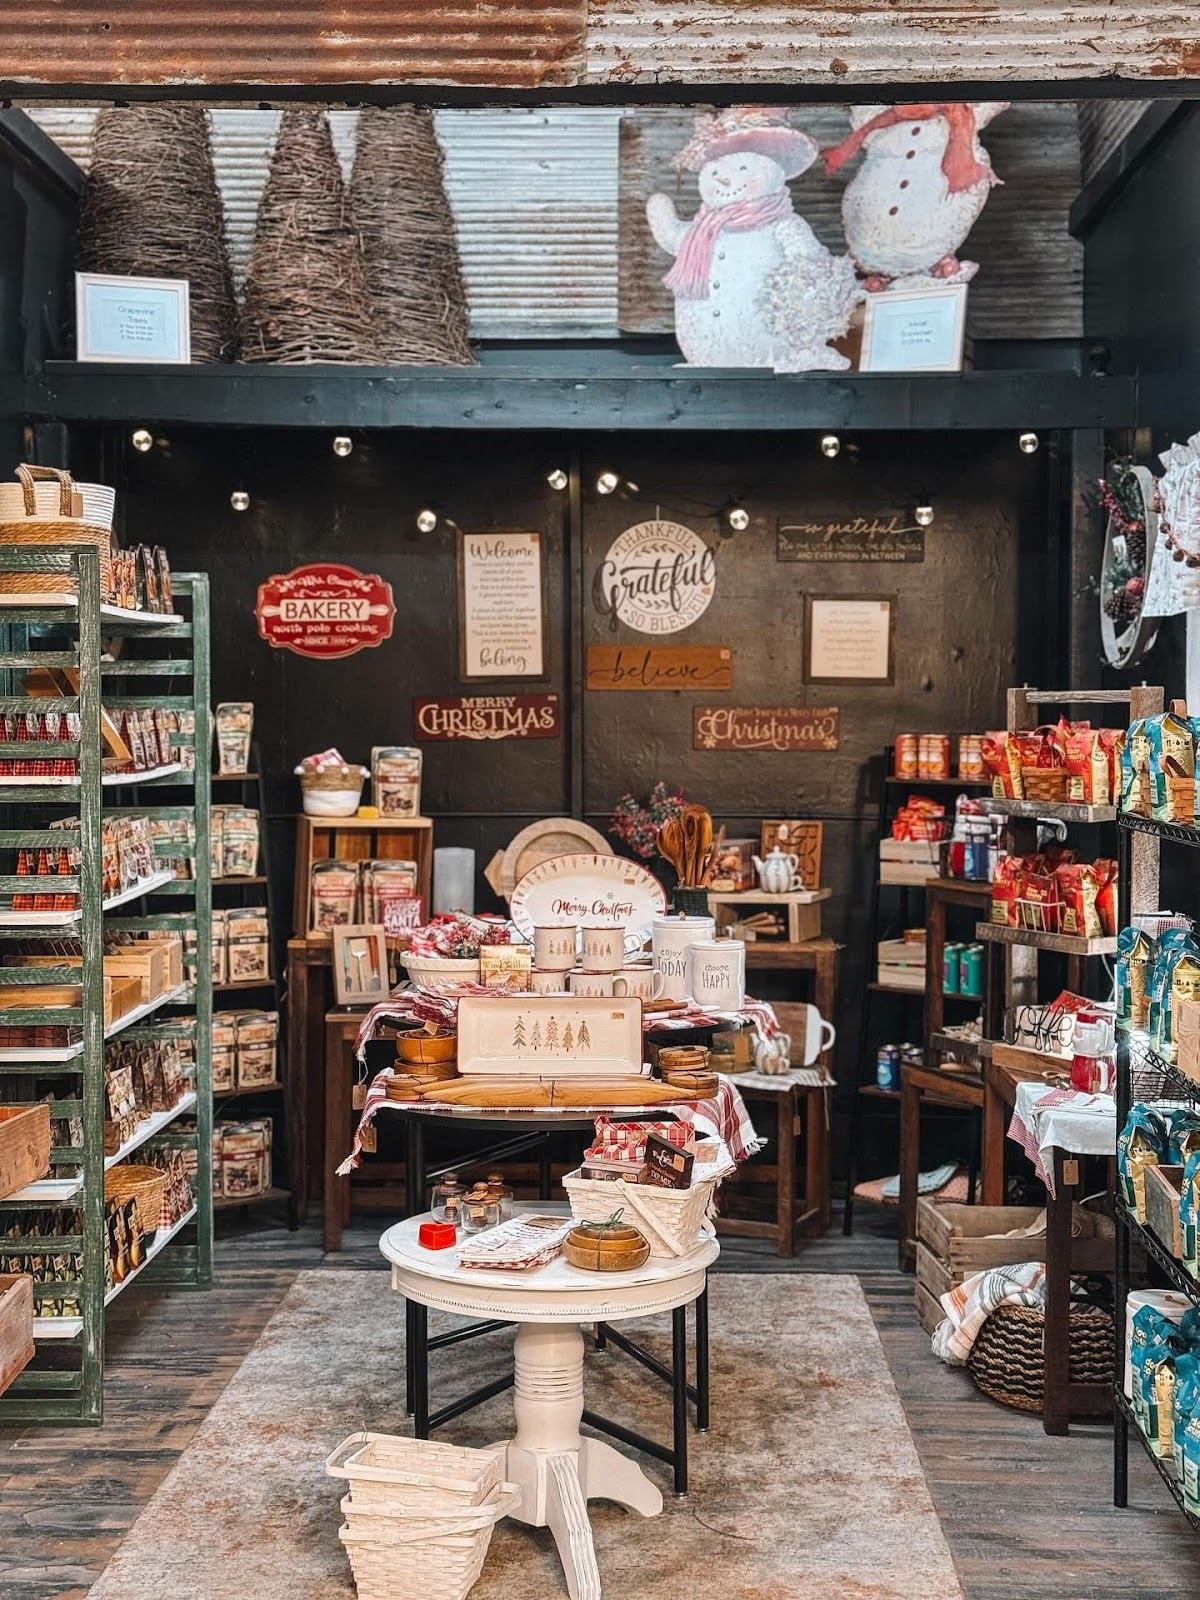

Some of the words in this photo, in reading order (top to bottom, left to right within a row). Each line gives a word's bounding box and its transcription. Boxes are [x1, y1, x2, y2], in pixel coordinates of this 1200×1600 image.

[614, 522, 696, 553] THANKFUL
[823, 516, 902, 542] grateful
[470, 540, 535, 560] Welcome
[592, 546, 716, 632] Grateful
[285, 601, 364, 619] BAKERY
[627, 609, 646, 628] SO
[650, 593, 707, 632] BLESSED
[272, 623, 303, 633] north
[306, 624, 331, 635] pole
[335, 623, 378, 635] cooking
[479, 647, 527, 673] belong
[604, 650, 716, 686] believe
[461, 696, 517, 709] MERRY
[418, 703, 556, 735] CHRISTMAS
[699, 709, 836, 749] Christmas
[551, 899, 590, 916] Merry
[592, 899, 636, 921] Christmas
[661, 949, 682, 960] enjoy
[657, 956, 687, 978] TODAY
[705, 964, 729, 972] choose
[702, 972, 730, 989] HAPPY
